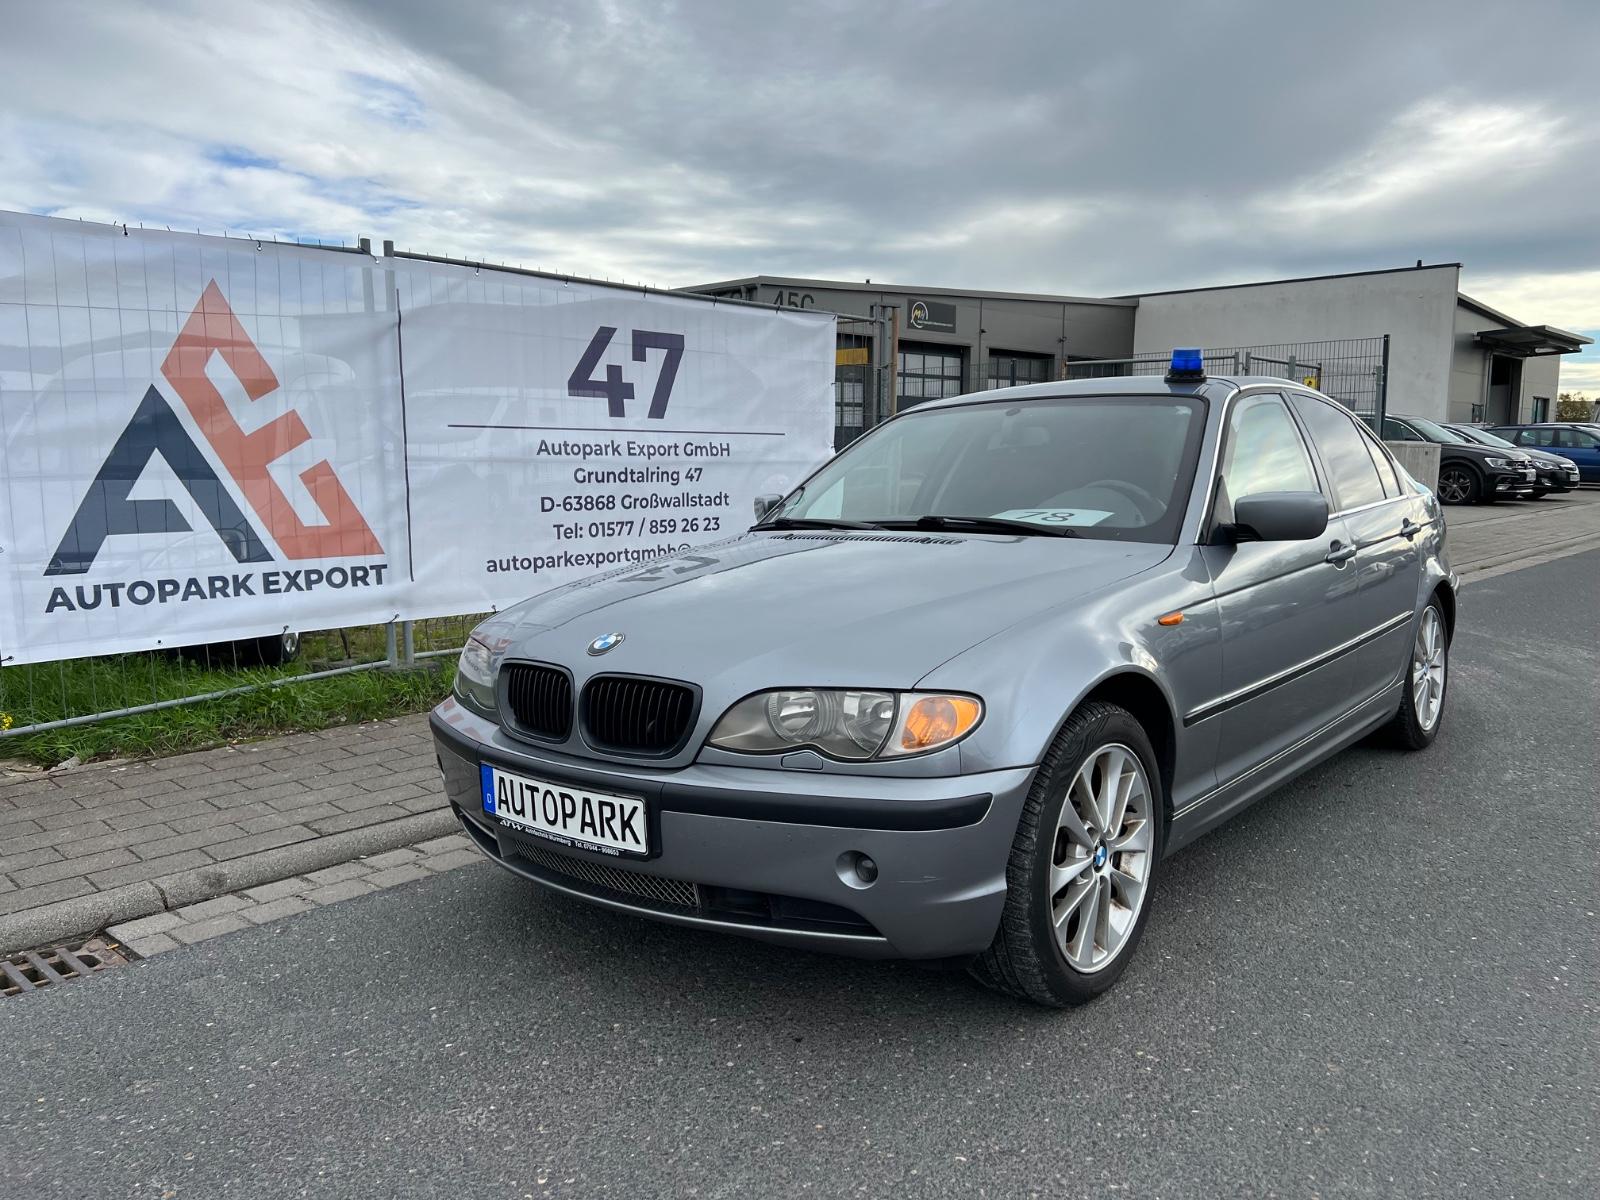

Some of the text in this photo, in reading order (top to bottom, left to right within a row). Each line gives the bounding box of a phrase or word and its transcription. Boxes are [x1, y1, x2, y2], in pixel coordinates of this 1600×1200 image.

[567, 325, 685, 420] 47
[536, 440, 731, 460] Autopark Export GmbH
[573, 467, 703, 486] Grundtalring 47
[540, 491, 730, 513] D-63868 Großwallstadt
[553, 522, 584, 540] Tel:
[588, 521, 634, 538] 01577
[649, 519, 677, 535] 859
[681, 518, 699, 533] 26
[703, 517, 720, 532] 23
[45, 563, 388, 613] AUTOPARK EXPORT
[498, 775, 641, 845] AUTOPARK
